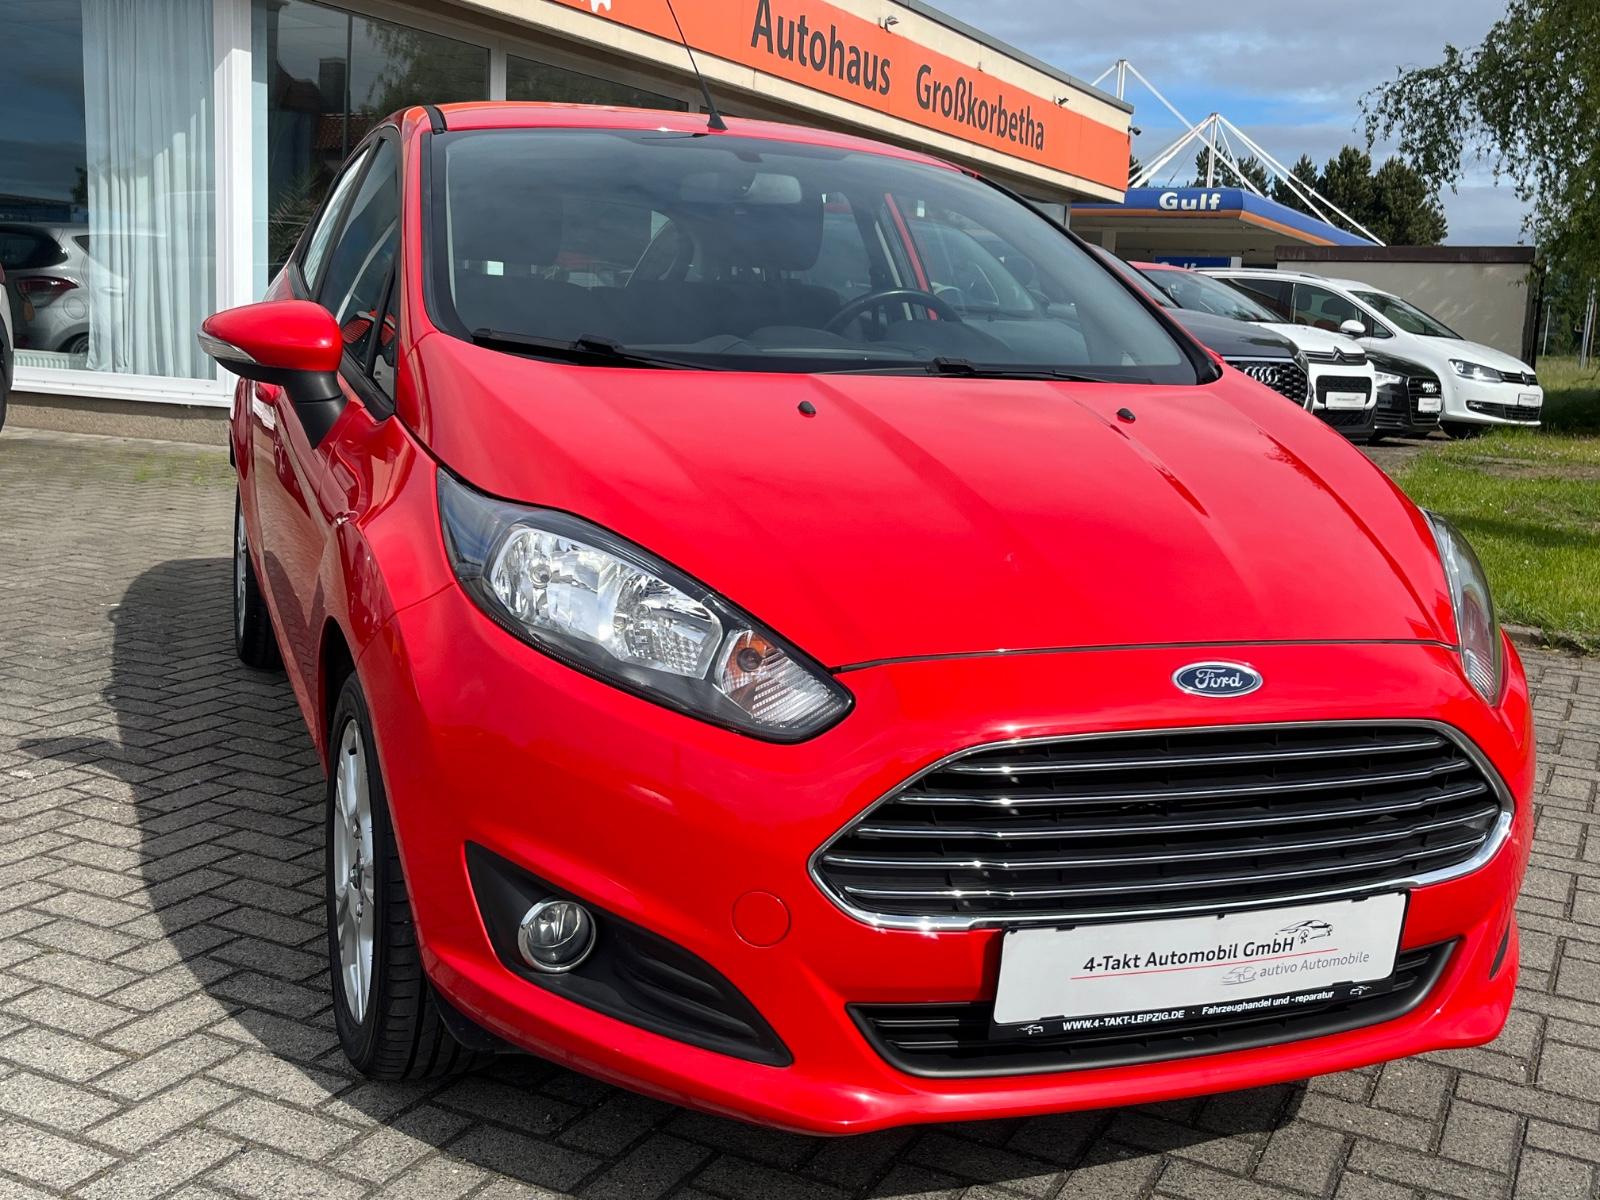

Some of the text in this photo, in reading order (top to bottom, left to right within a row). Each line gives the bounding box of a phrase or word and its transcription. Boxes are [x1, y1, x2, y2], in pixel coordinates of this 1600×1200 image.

[751, 0, 1044, 151] Autohaus Großkorbetha
[1159, 191, 1221, 210] Gulf
[1195, 668, 1243, 688] Ford
[1083, 937, 1295, 972] 4-Takt Automobil GmbH
[1259, 951, 1370, 977] autivo Automobile
[1062, 1010, 1185, 1031] WWW.4-TAKT-LEIPZIG.DE
[1202, 996, 1271, 1016] Fahrzeughandel
[1273, 995, 1290, 1006] und
